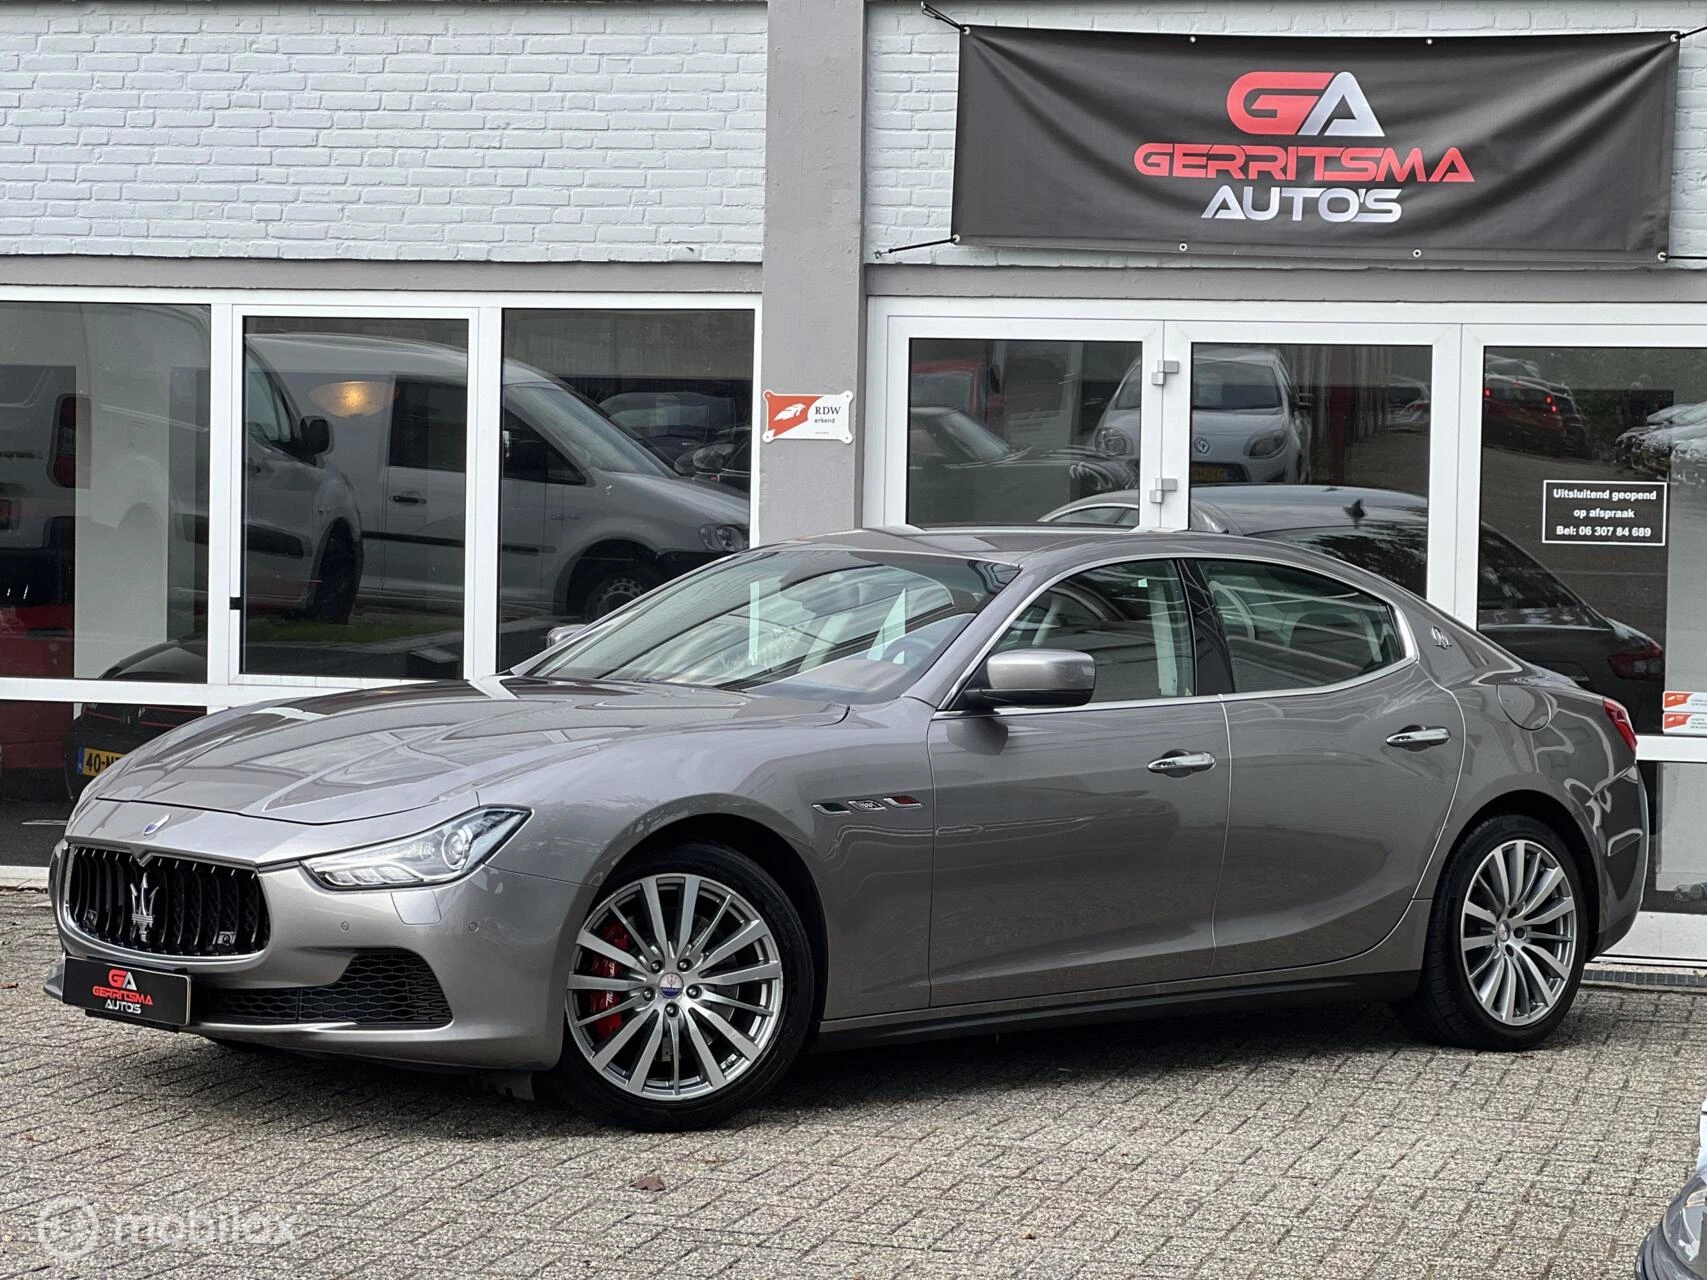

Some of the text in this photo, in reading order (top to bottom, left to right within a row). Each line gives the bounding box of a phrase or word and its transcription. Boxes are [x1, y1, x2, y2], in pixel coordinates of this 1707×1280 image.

[1227, 71, 1384, 136] GA
[1134, 142, 1475, 182] GERRITSMA
[1201, 185, 1401, 222] AUTO'S
[815, 406, 841, 415] RDW
[1553, 488, 1657, 501] Uitsluitend geopend
[1573, 508, 1635, 519] op afspraak
[1556, 525, 1651, 537] Bel: 06 307 84 689
[108, 968, 138, 991] GA
[92, 985, 153, 1005] GERRITSMA
